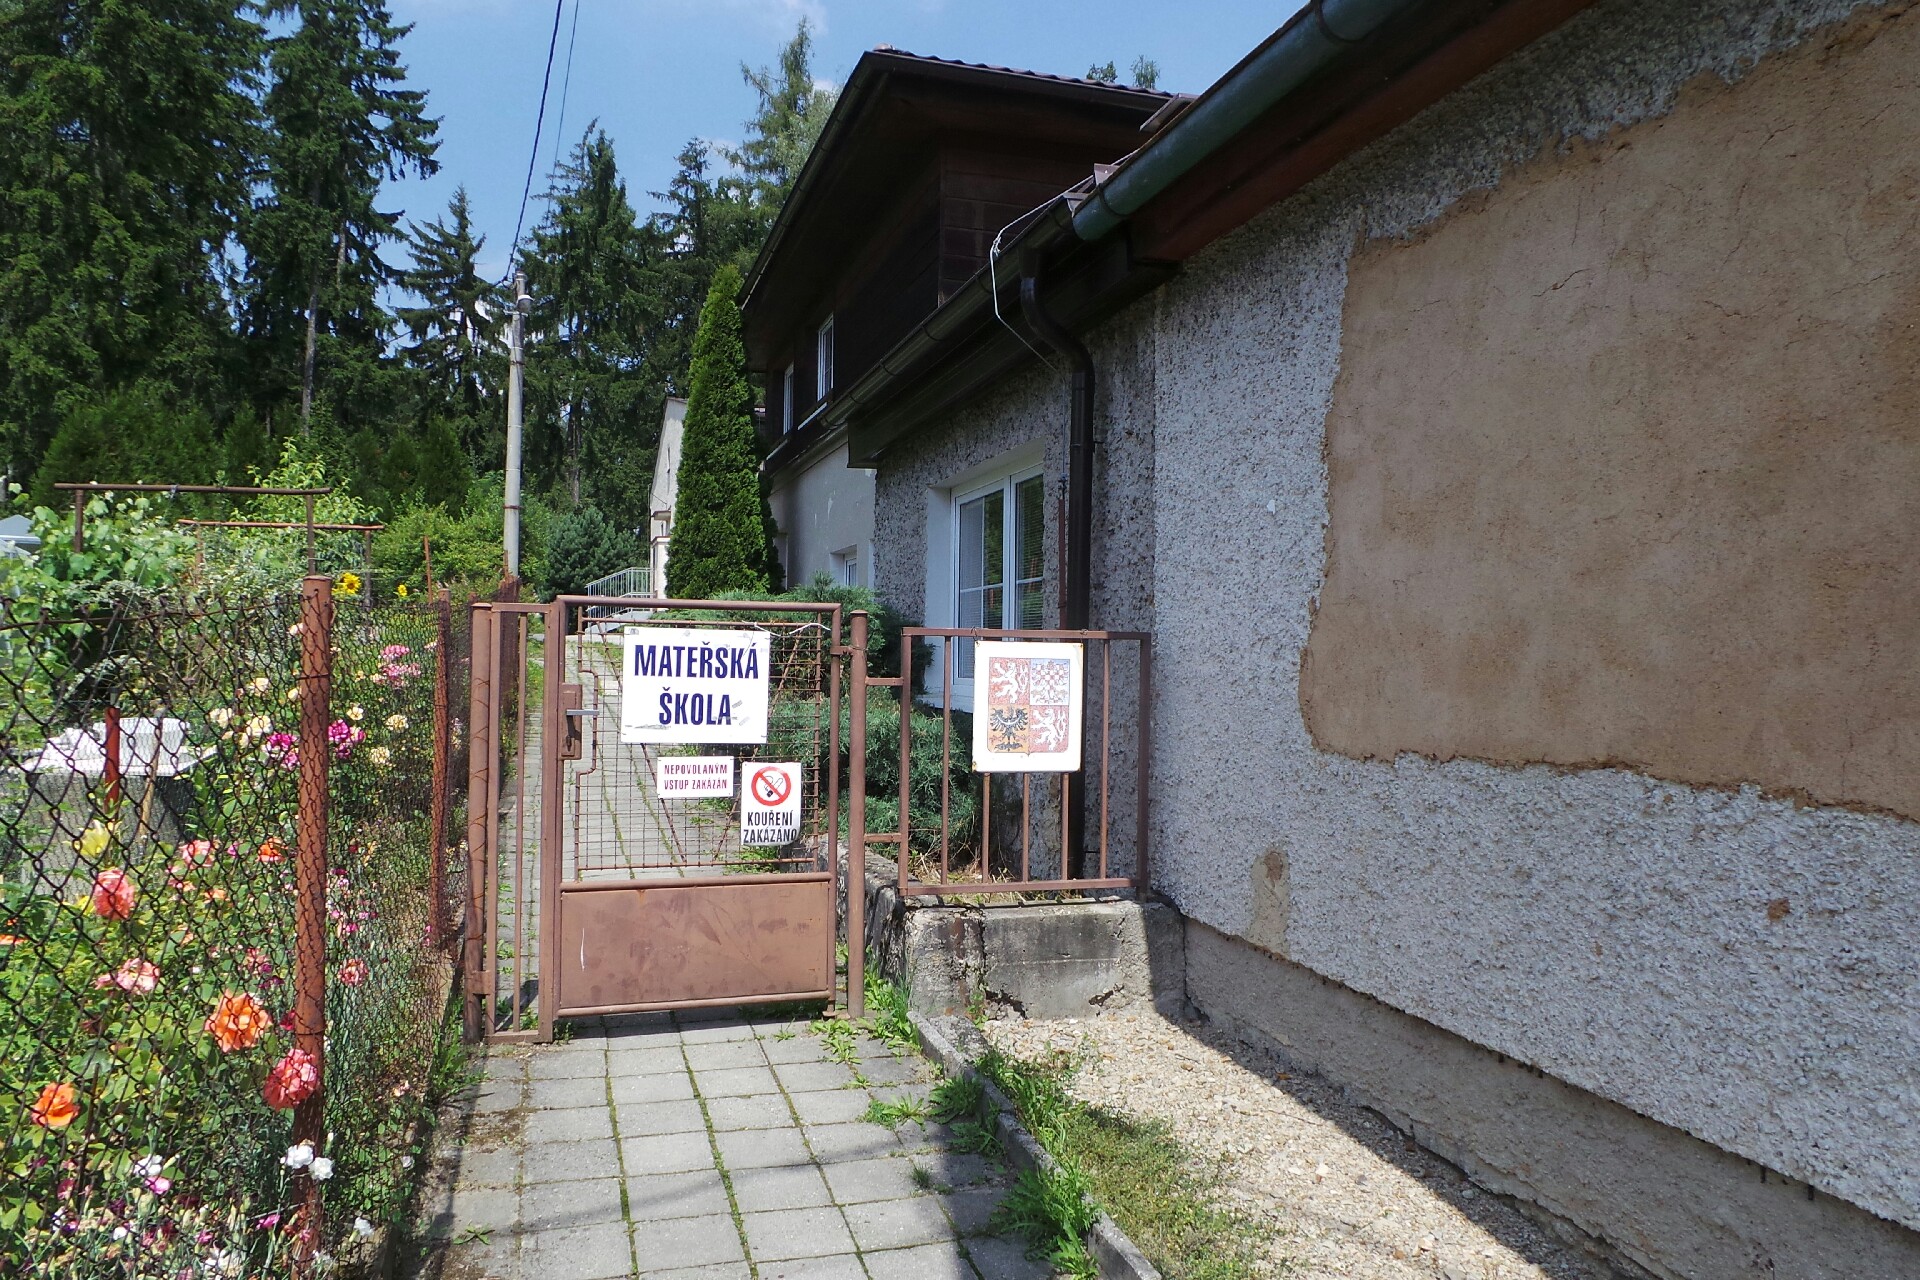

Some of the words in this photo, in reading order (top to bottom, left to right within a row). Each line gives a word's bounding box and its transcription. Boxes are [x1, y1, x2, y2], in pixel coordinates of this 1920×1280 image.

[634, 641, 759, 680] MATEŘSKÁ
[658, 687, 732, 725] ŠKOLA
[664, 763, 728, 775] NEPOVOLANÝM
[664, 779, 689, 790] VSTUP
[692, 777, 728, 790] ZAKÁZÁN
[747, 809, 793, 826] KOUŘENÍ
[743, 826, 797, 844] ZAKÁZÁNO
